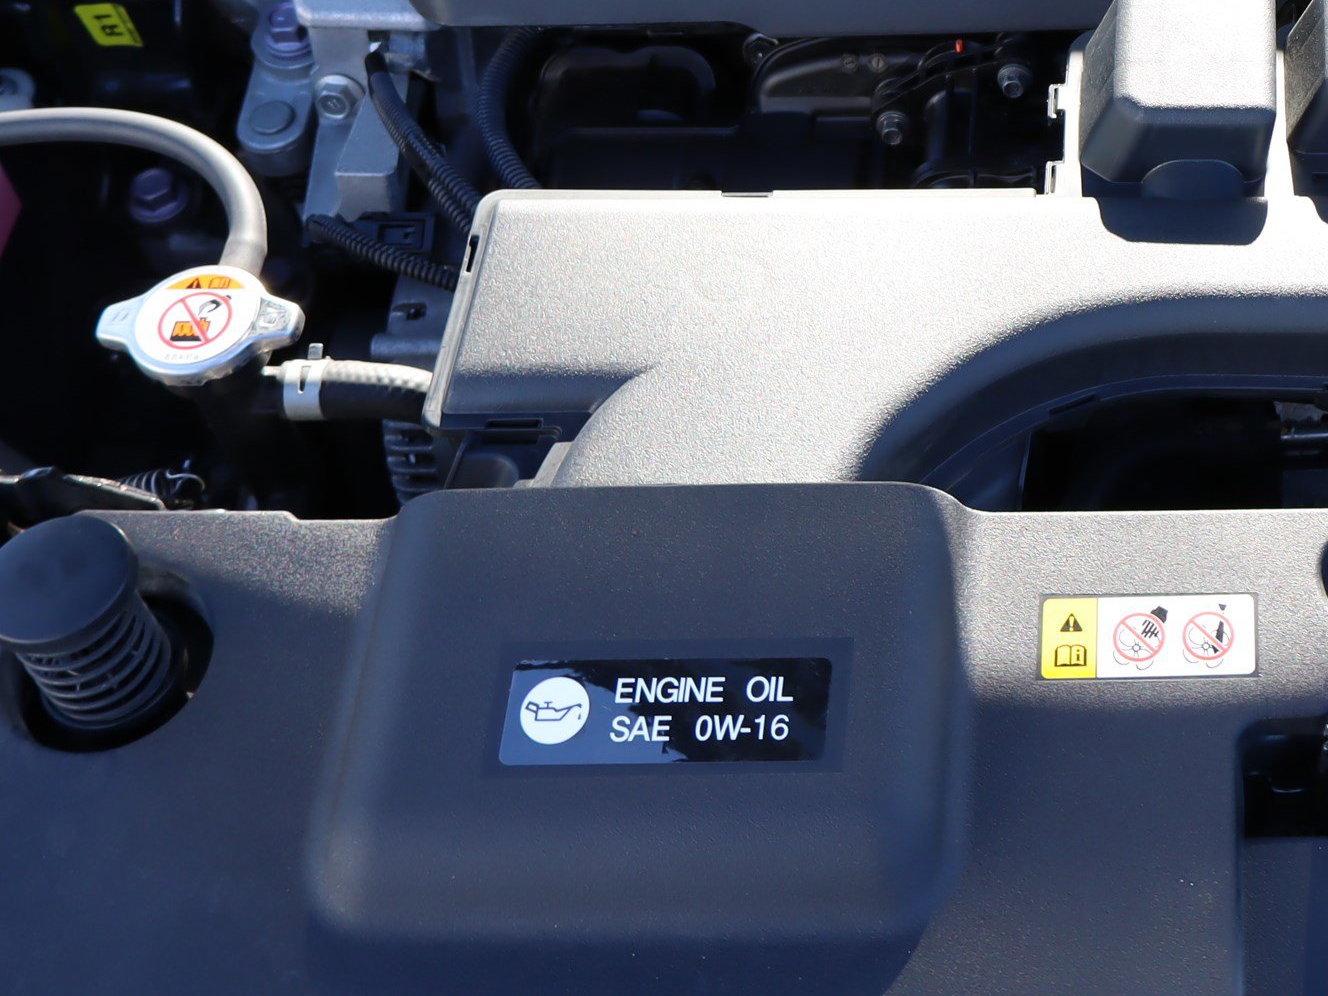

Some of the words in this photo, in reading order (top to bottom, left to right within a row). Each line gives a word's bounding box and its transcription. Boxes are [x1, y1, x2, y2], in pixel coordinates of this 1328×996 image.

[93, 14, 123, 36] R1
[614, 676, 726, 704] ENGINE
[746, 676, 795, 703] OIL
[609, 715, 673, 743] SAE
[694, 715, 790, 741] 0W-16
